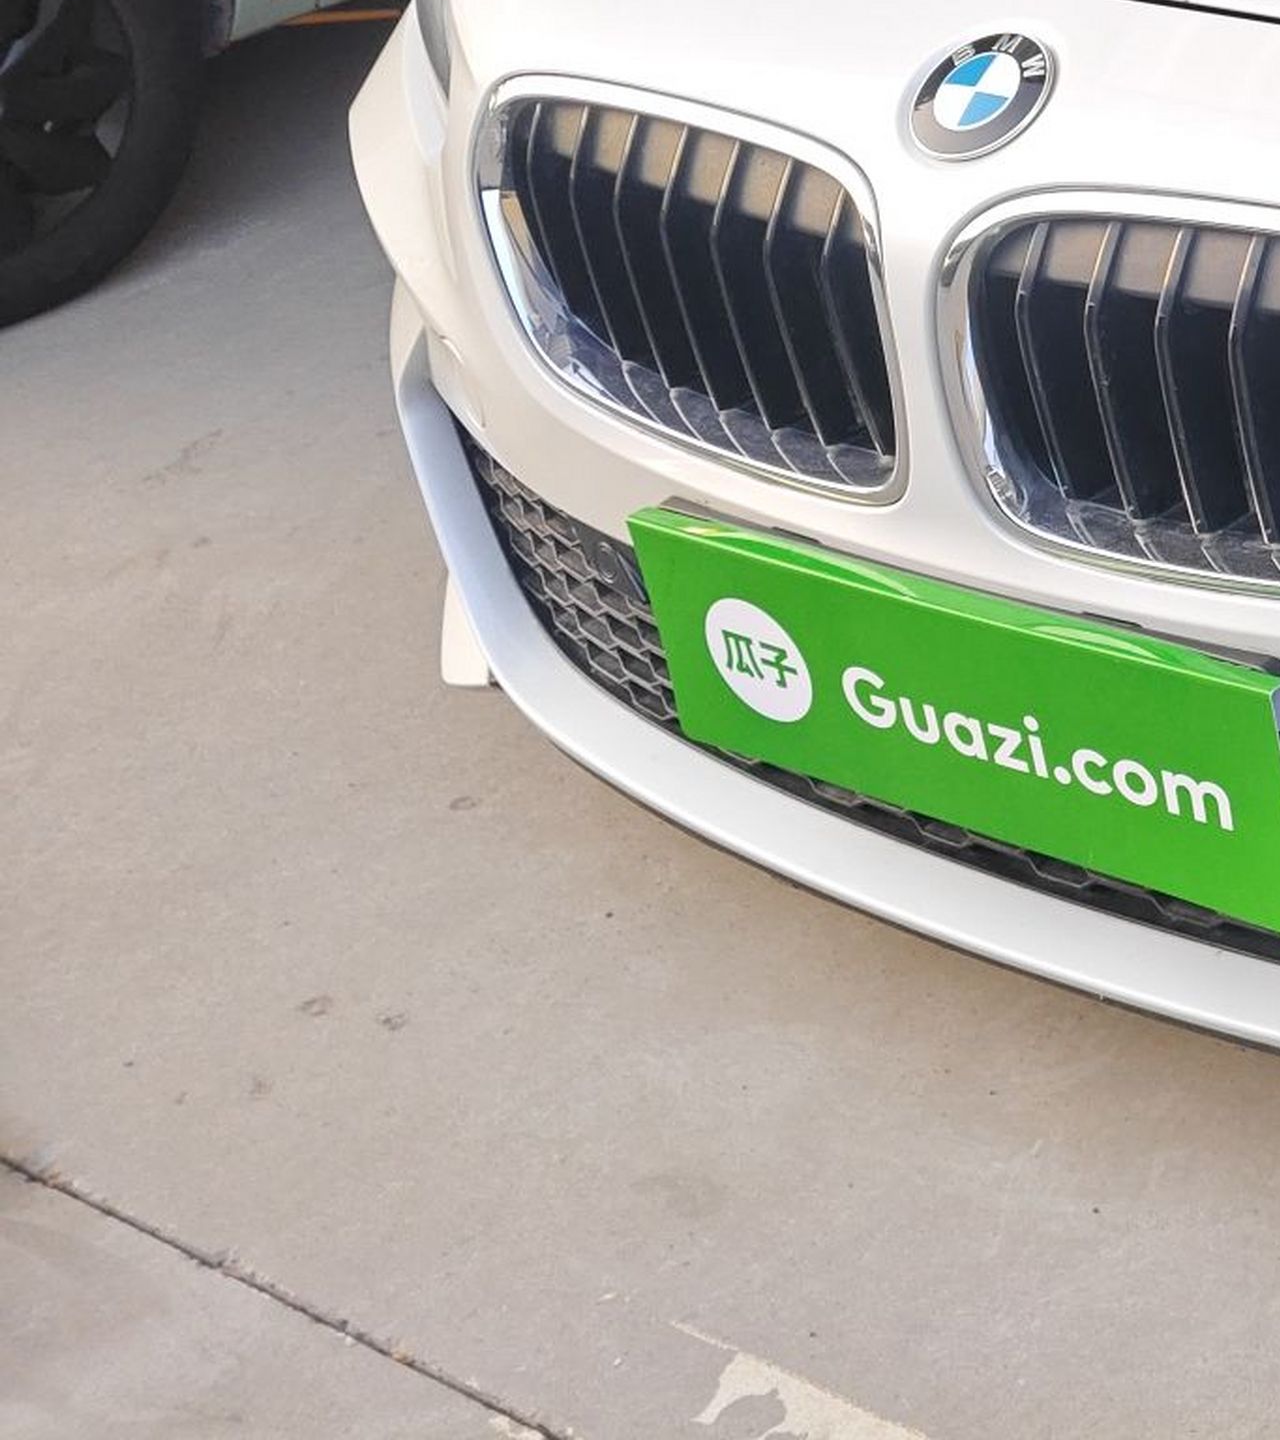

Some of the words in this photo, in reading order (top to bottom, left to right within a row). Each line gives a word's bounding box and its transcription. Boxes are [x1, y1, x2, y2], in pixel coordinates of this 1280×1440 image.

[951, 32, 1046, 78] BMW
[721, 629, 798, 689] 瓜子
[841, 666, 1235, 832] Guazi.com
